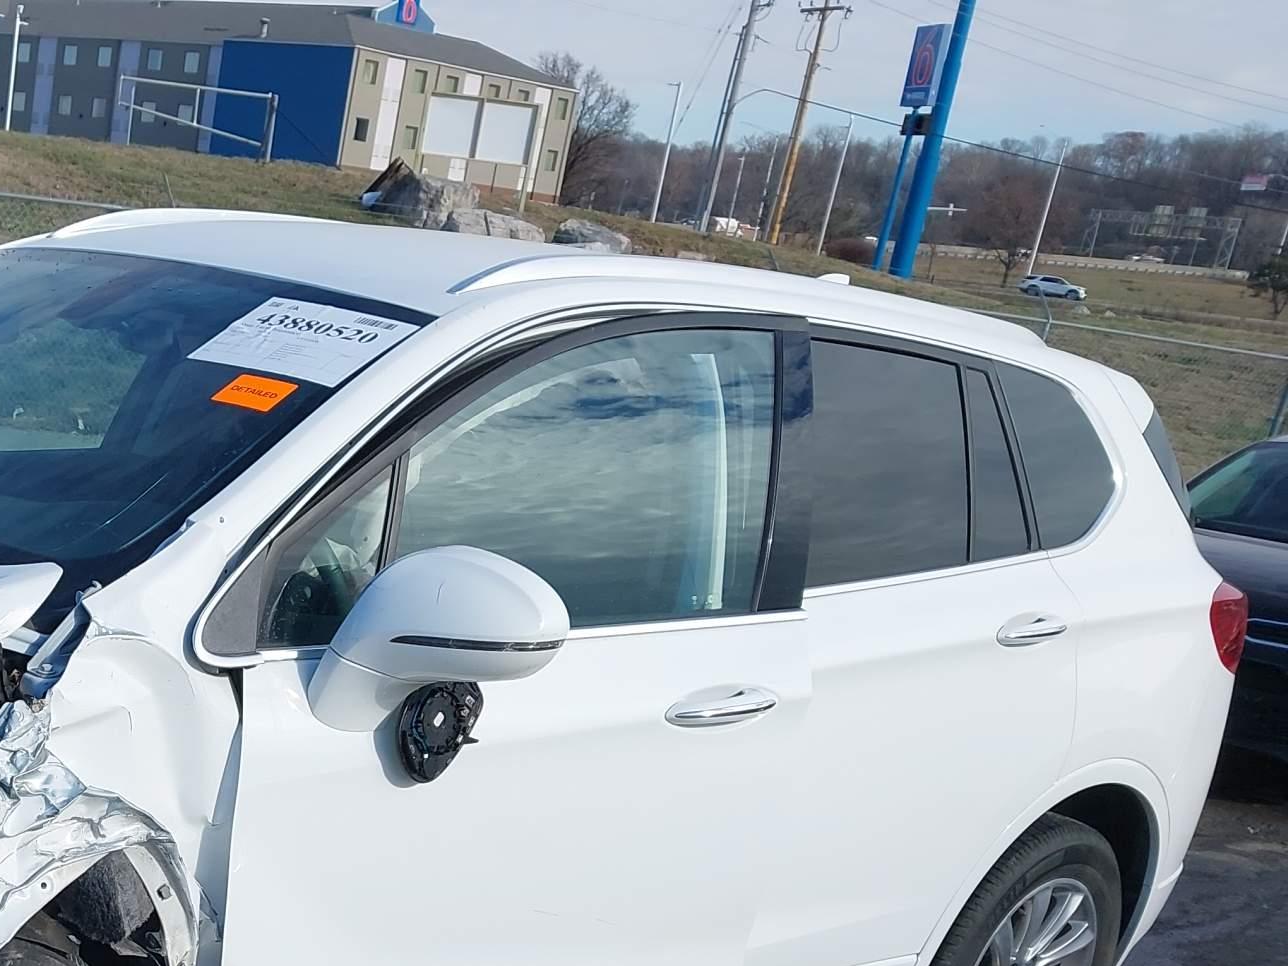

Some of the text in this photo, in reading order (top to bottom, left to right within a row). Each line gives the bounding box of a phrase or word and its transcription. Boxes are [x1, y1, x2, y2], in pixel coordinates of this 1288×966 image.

[912, 27, 935, 86] 6
[256, 313, 379, 343] 43880520
[230, 384, 278, 399] DETAILED
